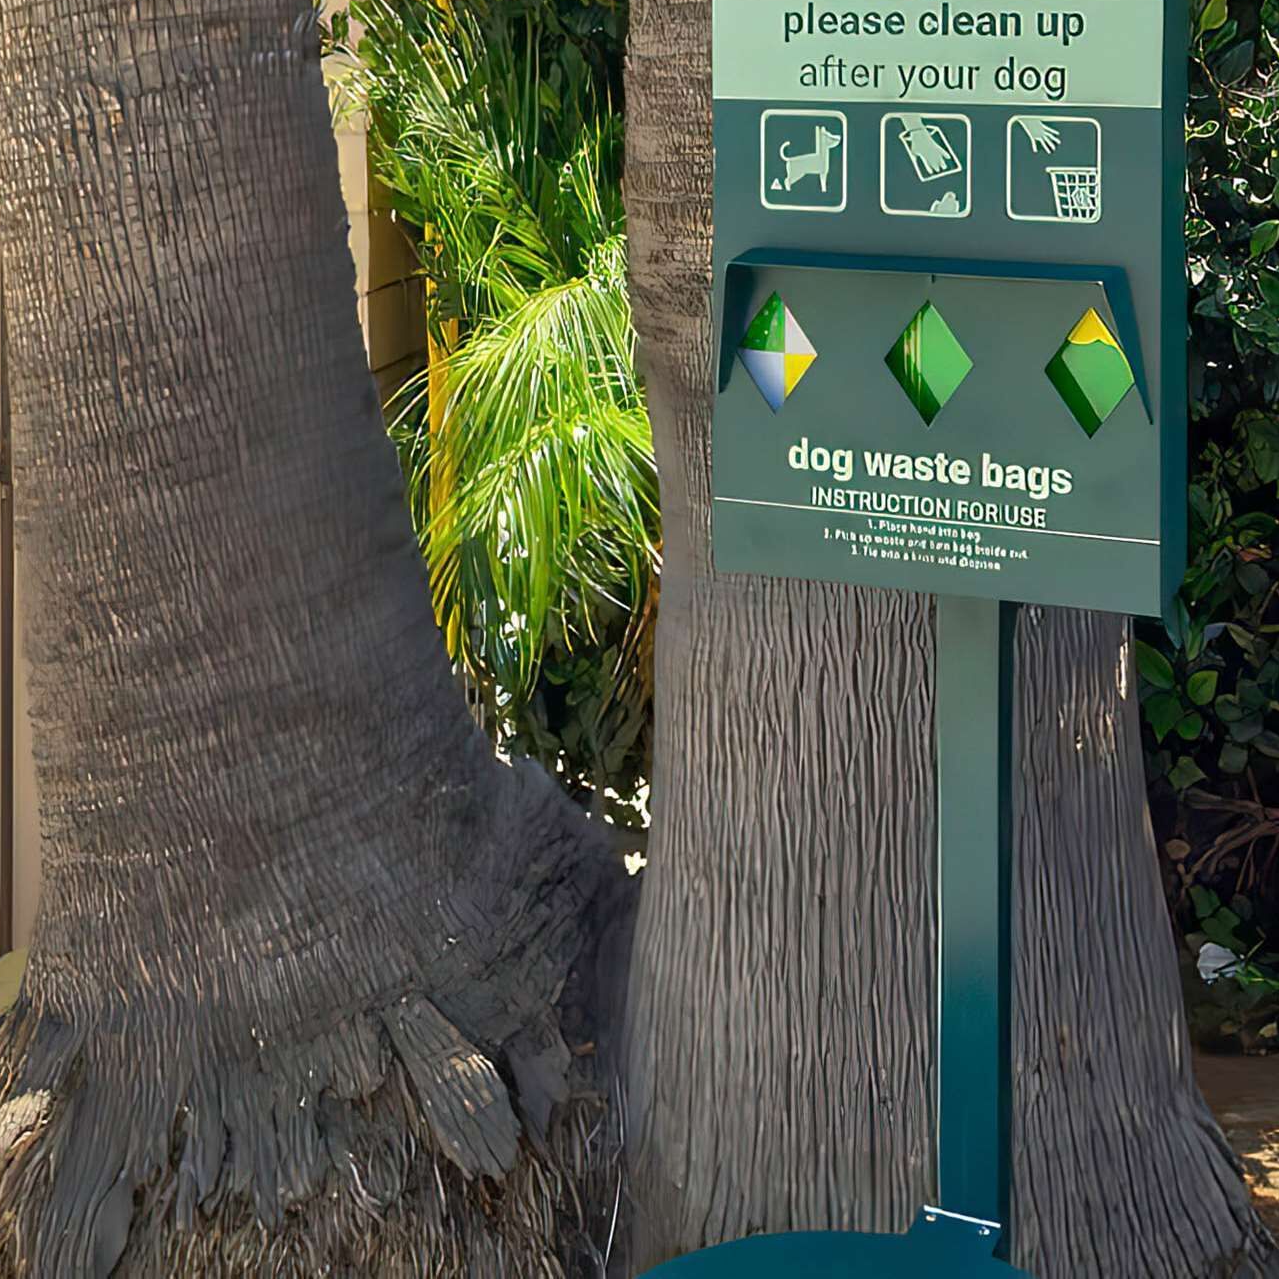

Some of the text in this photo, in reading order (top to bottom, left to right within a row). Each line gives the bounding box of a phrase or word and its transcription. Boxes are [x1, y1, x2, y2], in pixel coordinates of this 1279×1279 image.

[784, 2, 1084, 46] please clean up
[799, 54, 1067, 100] after your dog
[788, 437, 1073, 500] dog waste bags
[812, 486, 1047, 527] INSTRUCTION FOR USE
